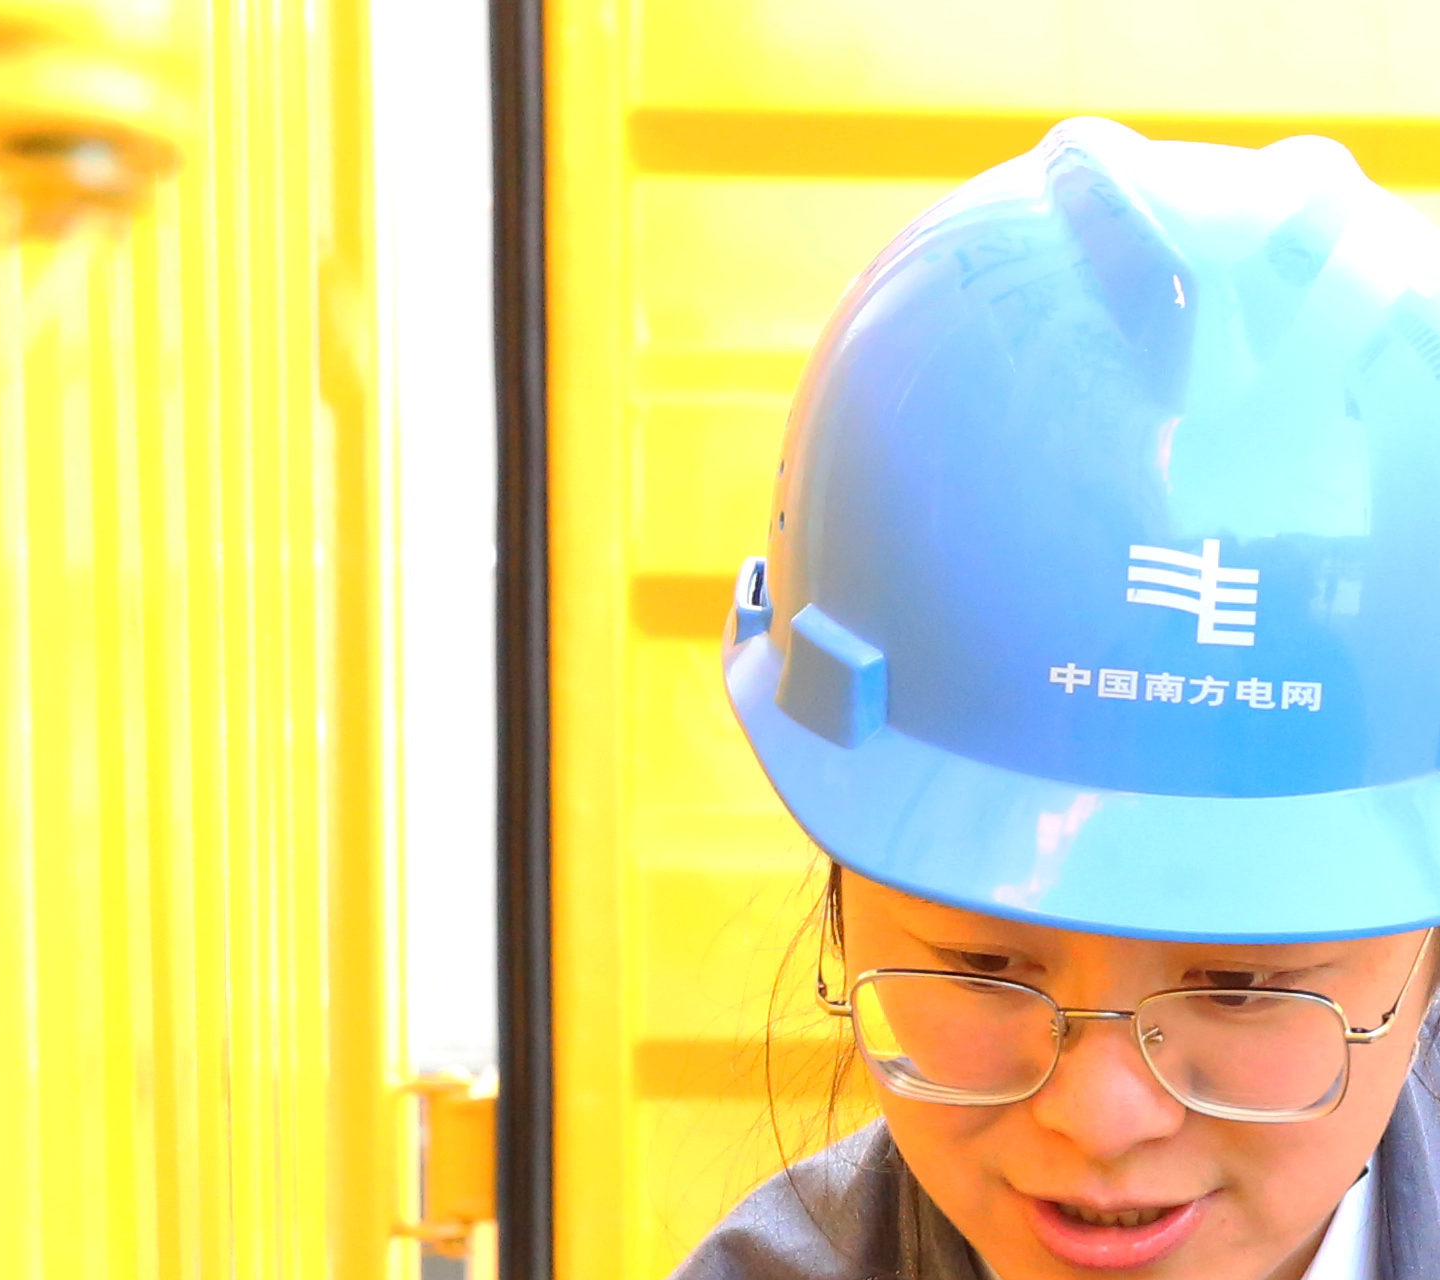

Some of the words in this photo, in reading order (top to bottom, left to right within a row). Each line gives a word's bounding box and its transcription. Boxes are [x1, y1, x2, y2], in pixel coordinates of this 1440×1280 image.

[1049, 662, 1322, 711] 中国南方电网
